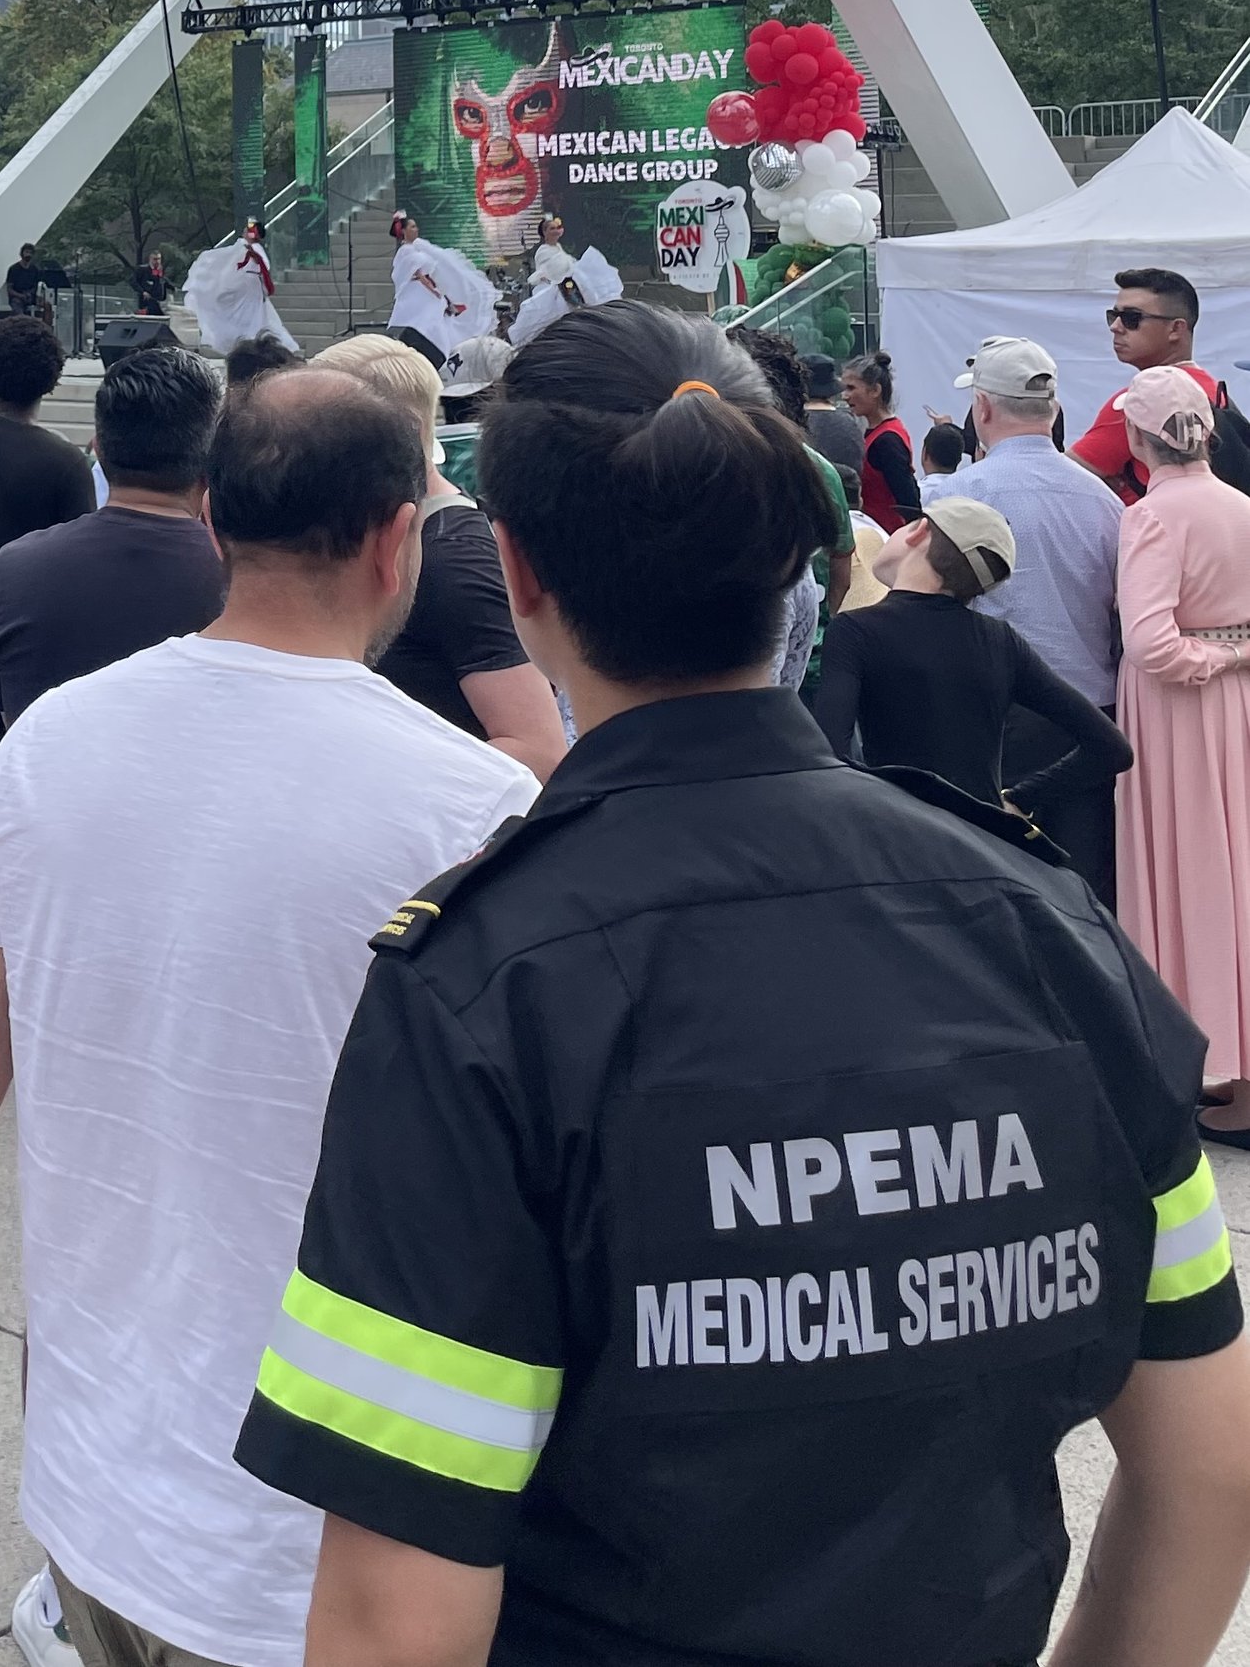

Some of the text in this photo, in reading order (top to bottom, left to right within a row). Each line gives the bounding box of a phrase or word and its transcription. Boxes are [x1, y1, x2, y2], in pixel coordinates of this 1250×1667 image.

[558, 49, 734, 88] MEXICANDAY
[537, 127, 744, 157] MEXICAN LEGA
[568, 159, 719, 184] DANCE GROUP
[659, 206, 704, 228] MEXI
[660, 226, 701, 247] CAN
[661, 247, 700, 267] DAY
[705, 1112, 1044, 1230] NPEMA
[635, 1222, 1101, 1368] MEDICAL SERVICES
